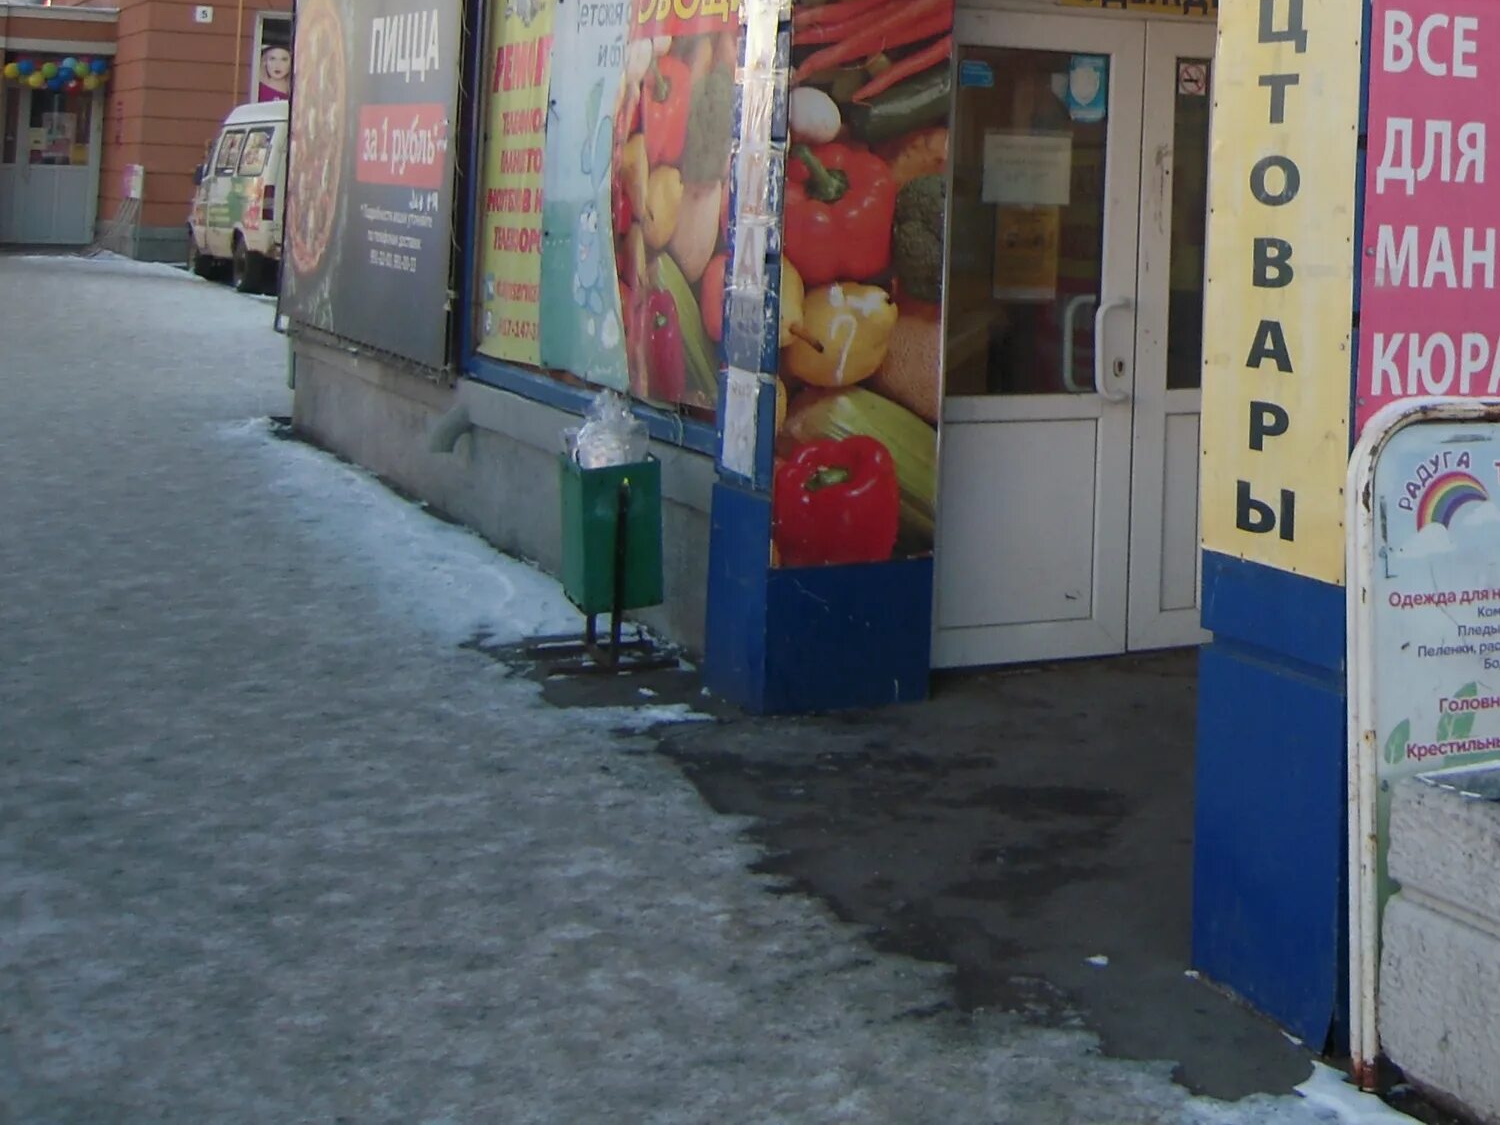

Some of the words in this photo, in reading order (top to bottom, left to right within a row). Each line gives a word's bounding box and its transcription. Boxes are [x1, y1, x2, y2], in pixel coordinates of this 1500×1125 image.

[369, 9, 440, 83] ПИЦЦА
[1383, 9, 1479, 78] ВСЕ
[1376, 117, 1486, 196] ДЛЯ
[1399, 451, 1471, 511] РАДУГА
[1388, 590, 1457, 610] Одежда
[1460, 588, 1490, 607] для
